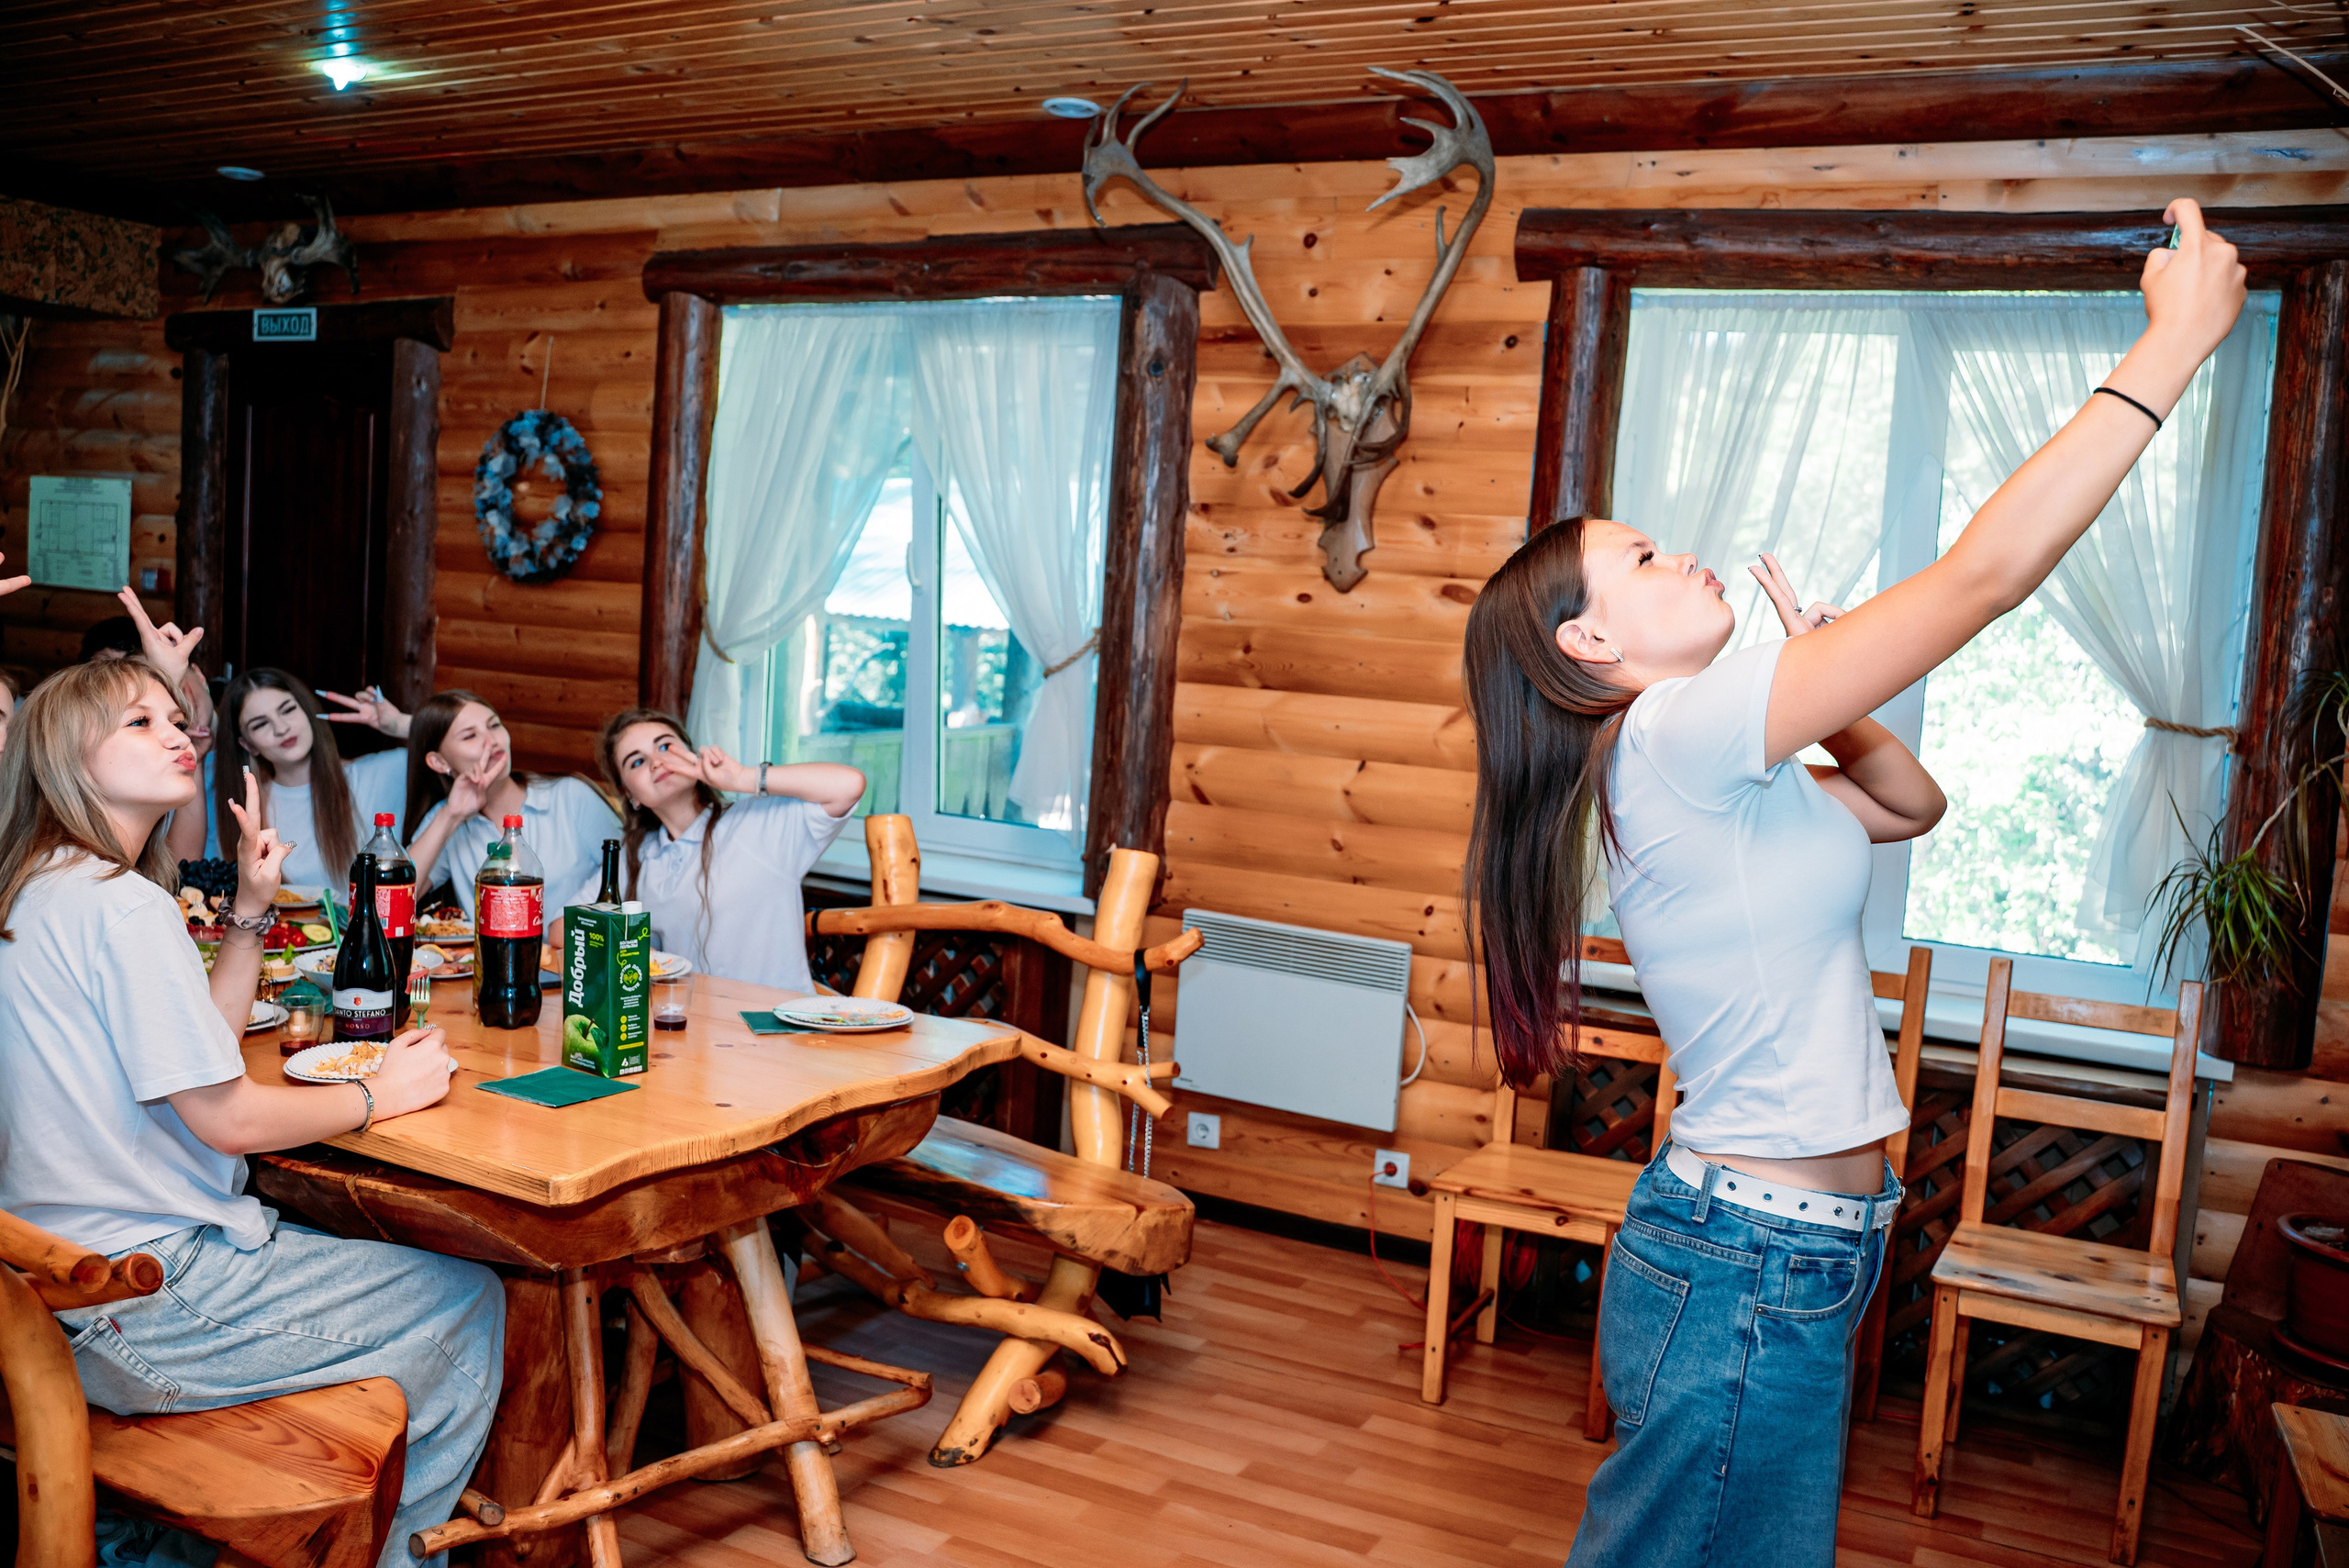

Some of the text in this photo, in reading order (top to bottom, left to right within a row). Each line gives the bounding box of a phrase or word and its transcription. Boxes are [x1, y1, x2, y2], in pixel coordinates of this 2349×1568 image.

[261, 316, 310, 335] ВЫХОД
[589, 932, 605, 942] 100%
[568, 928, 587, 1008] Добрый
[353, 1009, 386, 1018] STEFANO
